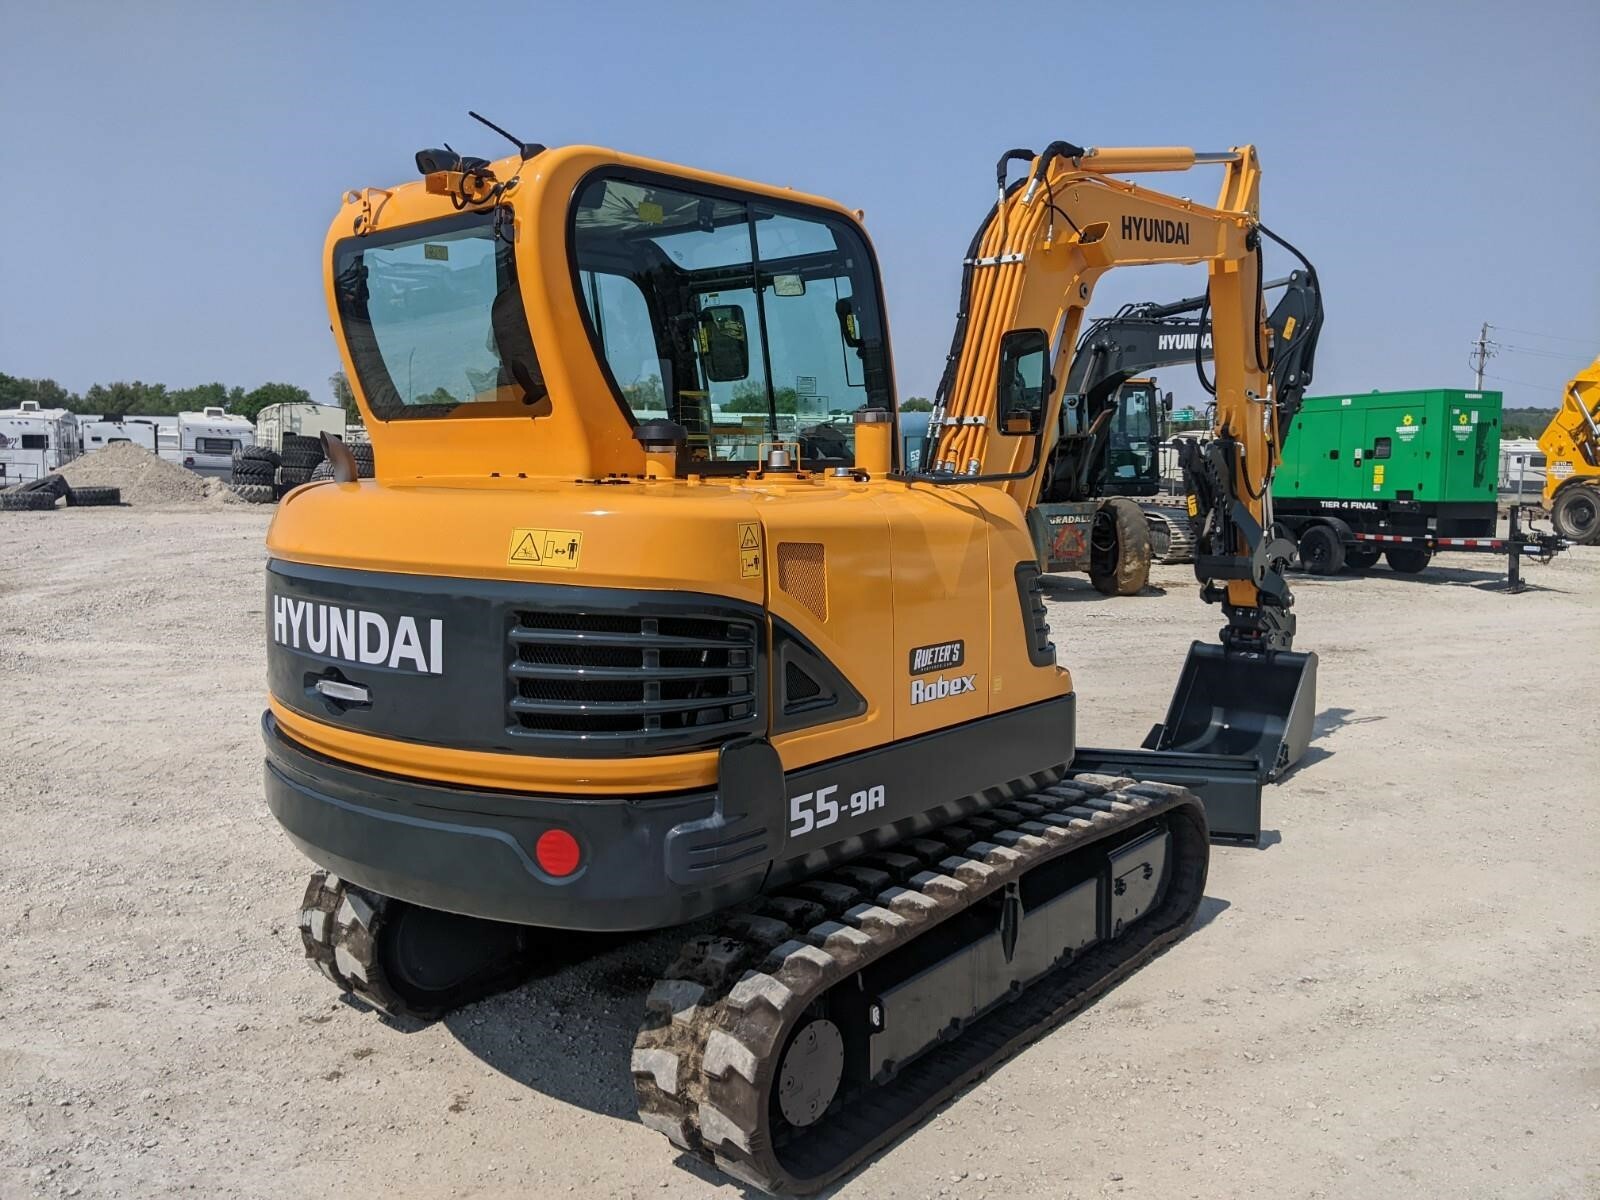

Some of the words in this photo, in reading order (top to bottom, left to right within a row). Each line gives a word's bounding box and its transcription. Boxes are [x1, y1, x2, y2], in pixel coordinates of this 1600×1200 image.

[1121, 215, 1190, 245] HYUNDAI
[1320, 501, 1340, 509] TIER
[1341, 501, 1348, 509] 4
[1350, 502, 1378, 510] FINAL
[273, 594, 443, 674] HYUNDAI
[913, 643, 961, 671] RUETER'S
[910, 674, 977, 705] Robex
[790, 784, 885, 838] 55-9A
